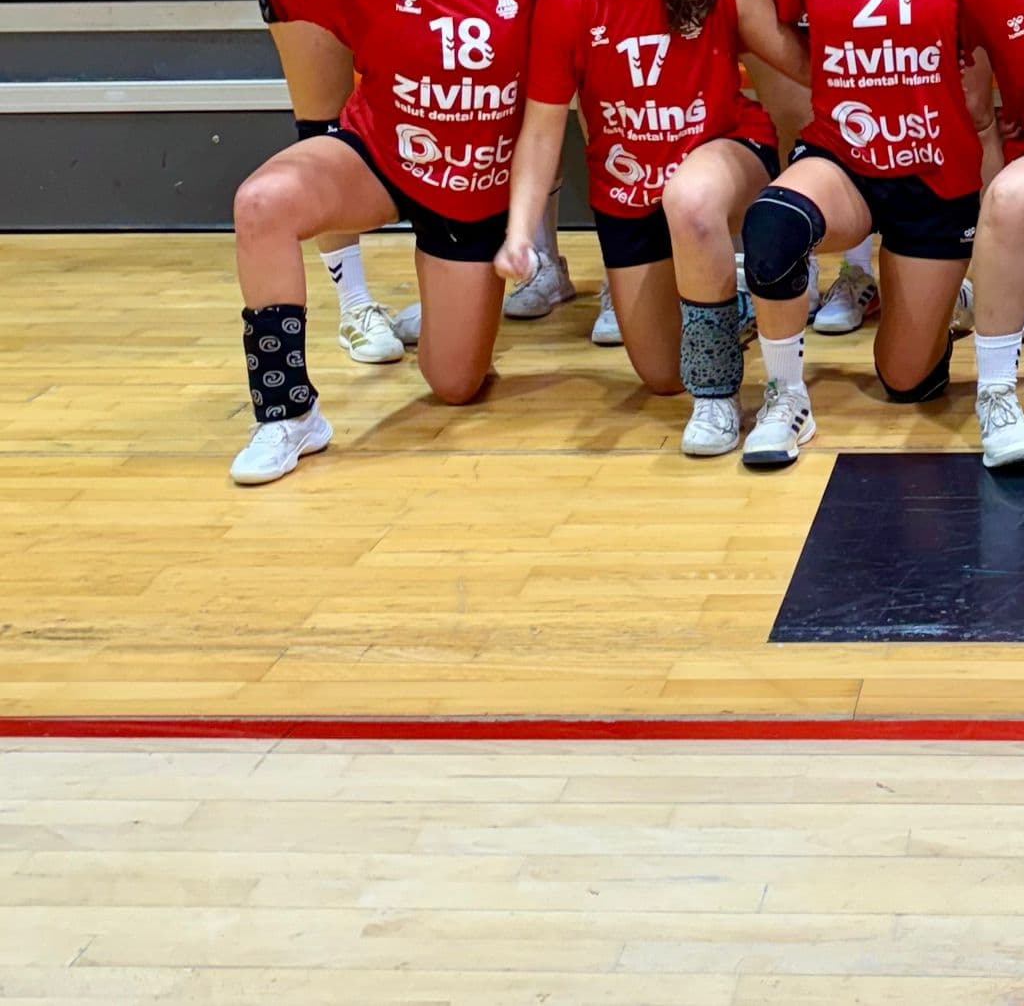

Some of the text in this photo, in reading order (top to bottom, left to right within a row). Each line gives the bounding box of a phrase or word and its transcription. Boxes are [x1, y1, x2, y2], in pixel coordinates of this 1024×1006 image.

[429, 16, 495, 71] 18
[615, 34, 671, 88] 17
[858, 74, 899, 88] dental
[394, 100, 425, 118] salut
[428, 110, 474, 122] dental
